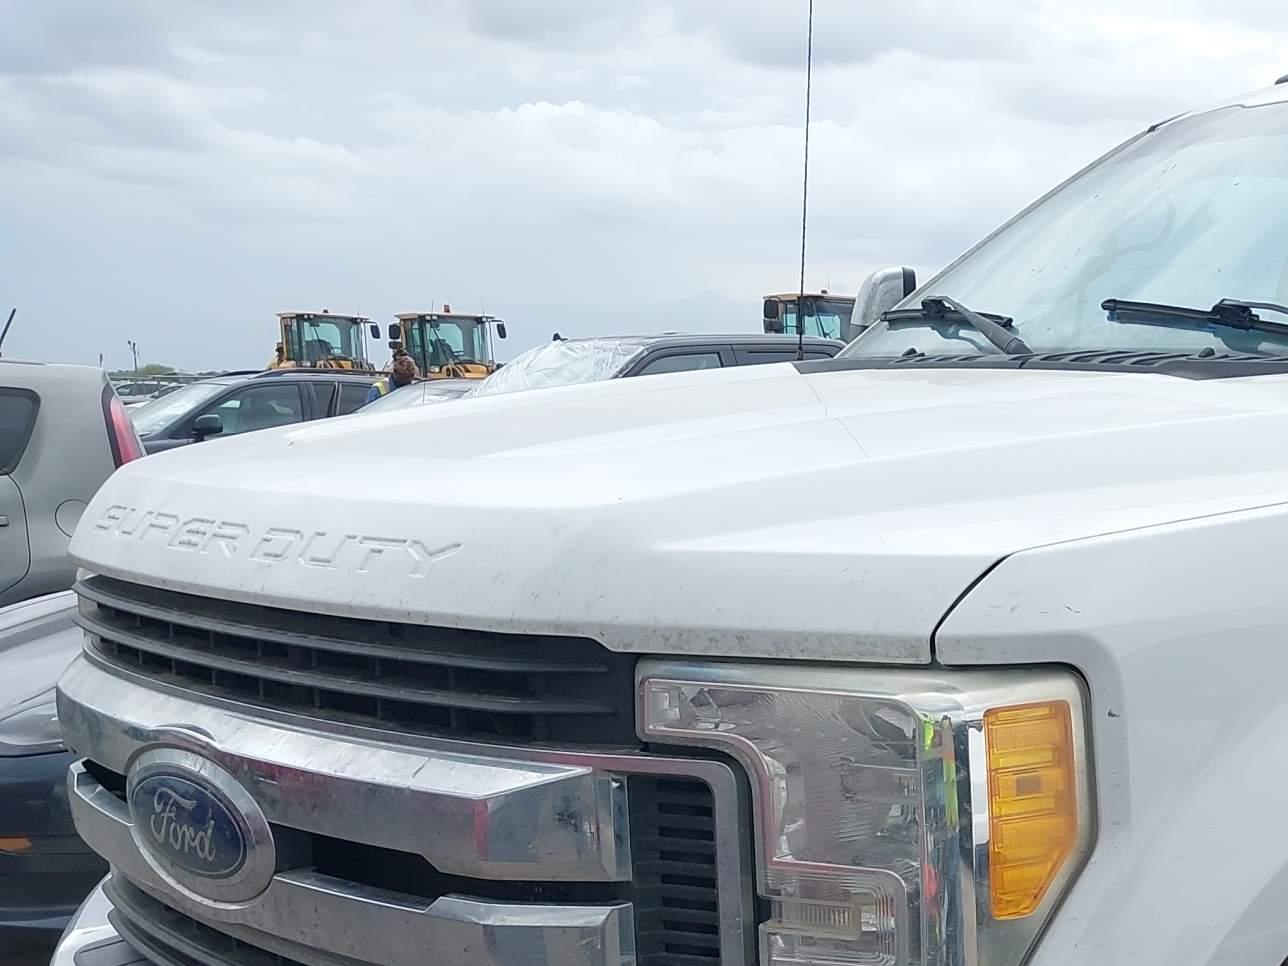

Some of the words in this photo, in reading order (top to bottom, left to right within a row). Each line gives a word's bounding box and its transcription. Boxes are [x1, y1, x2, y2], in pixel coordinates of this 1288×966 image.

[95, 504, 250, 557] SUPER
[248, 527, 463, 579] DUTY
[150, 787, 216, 862] Ford
